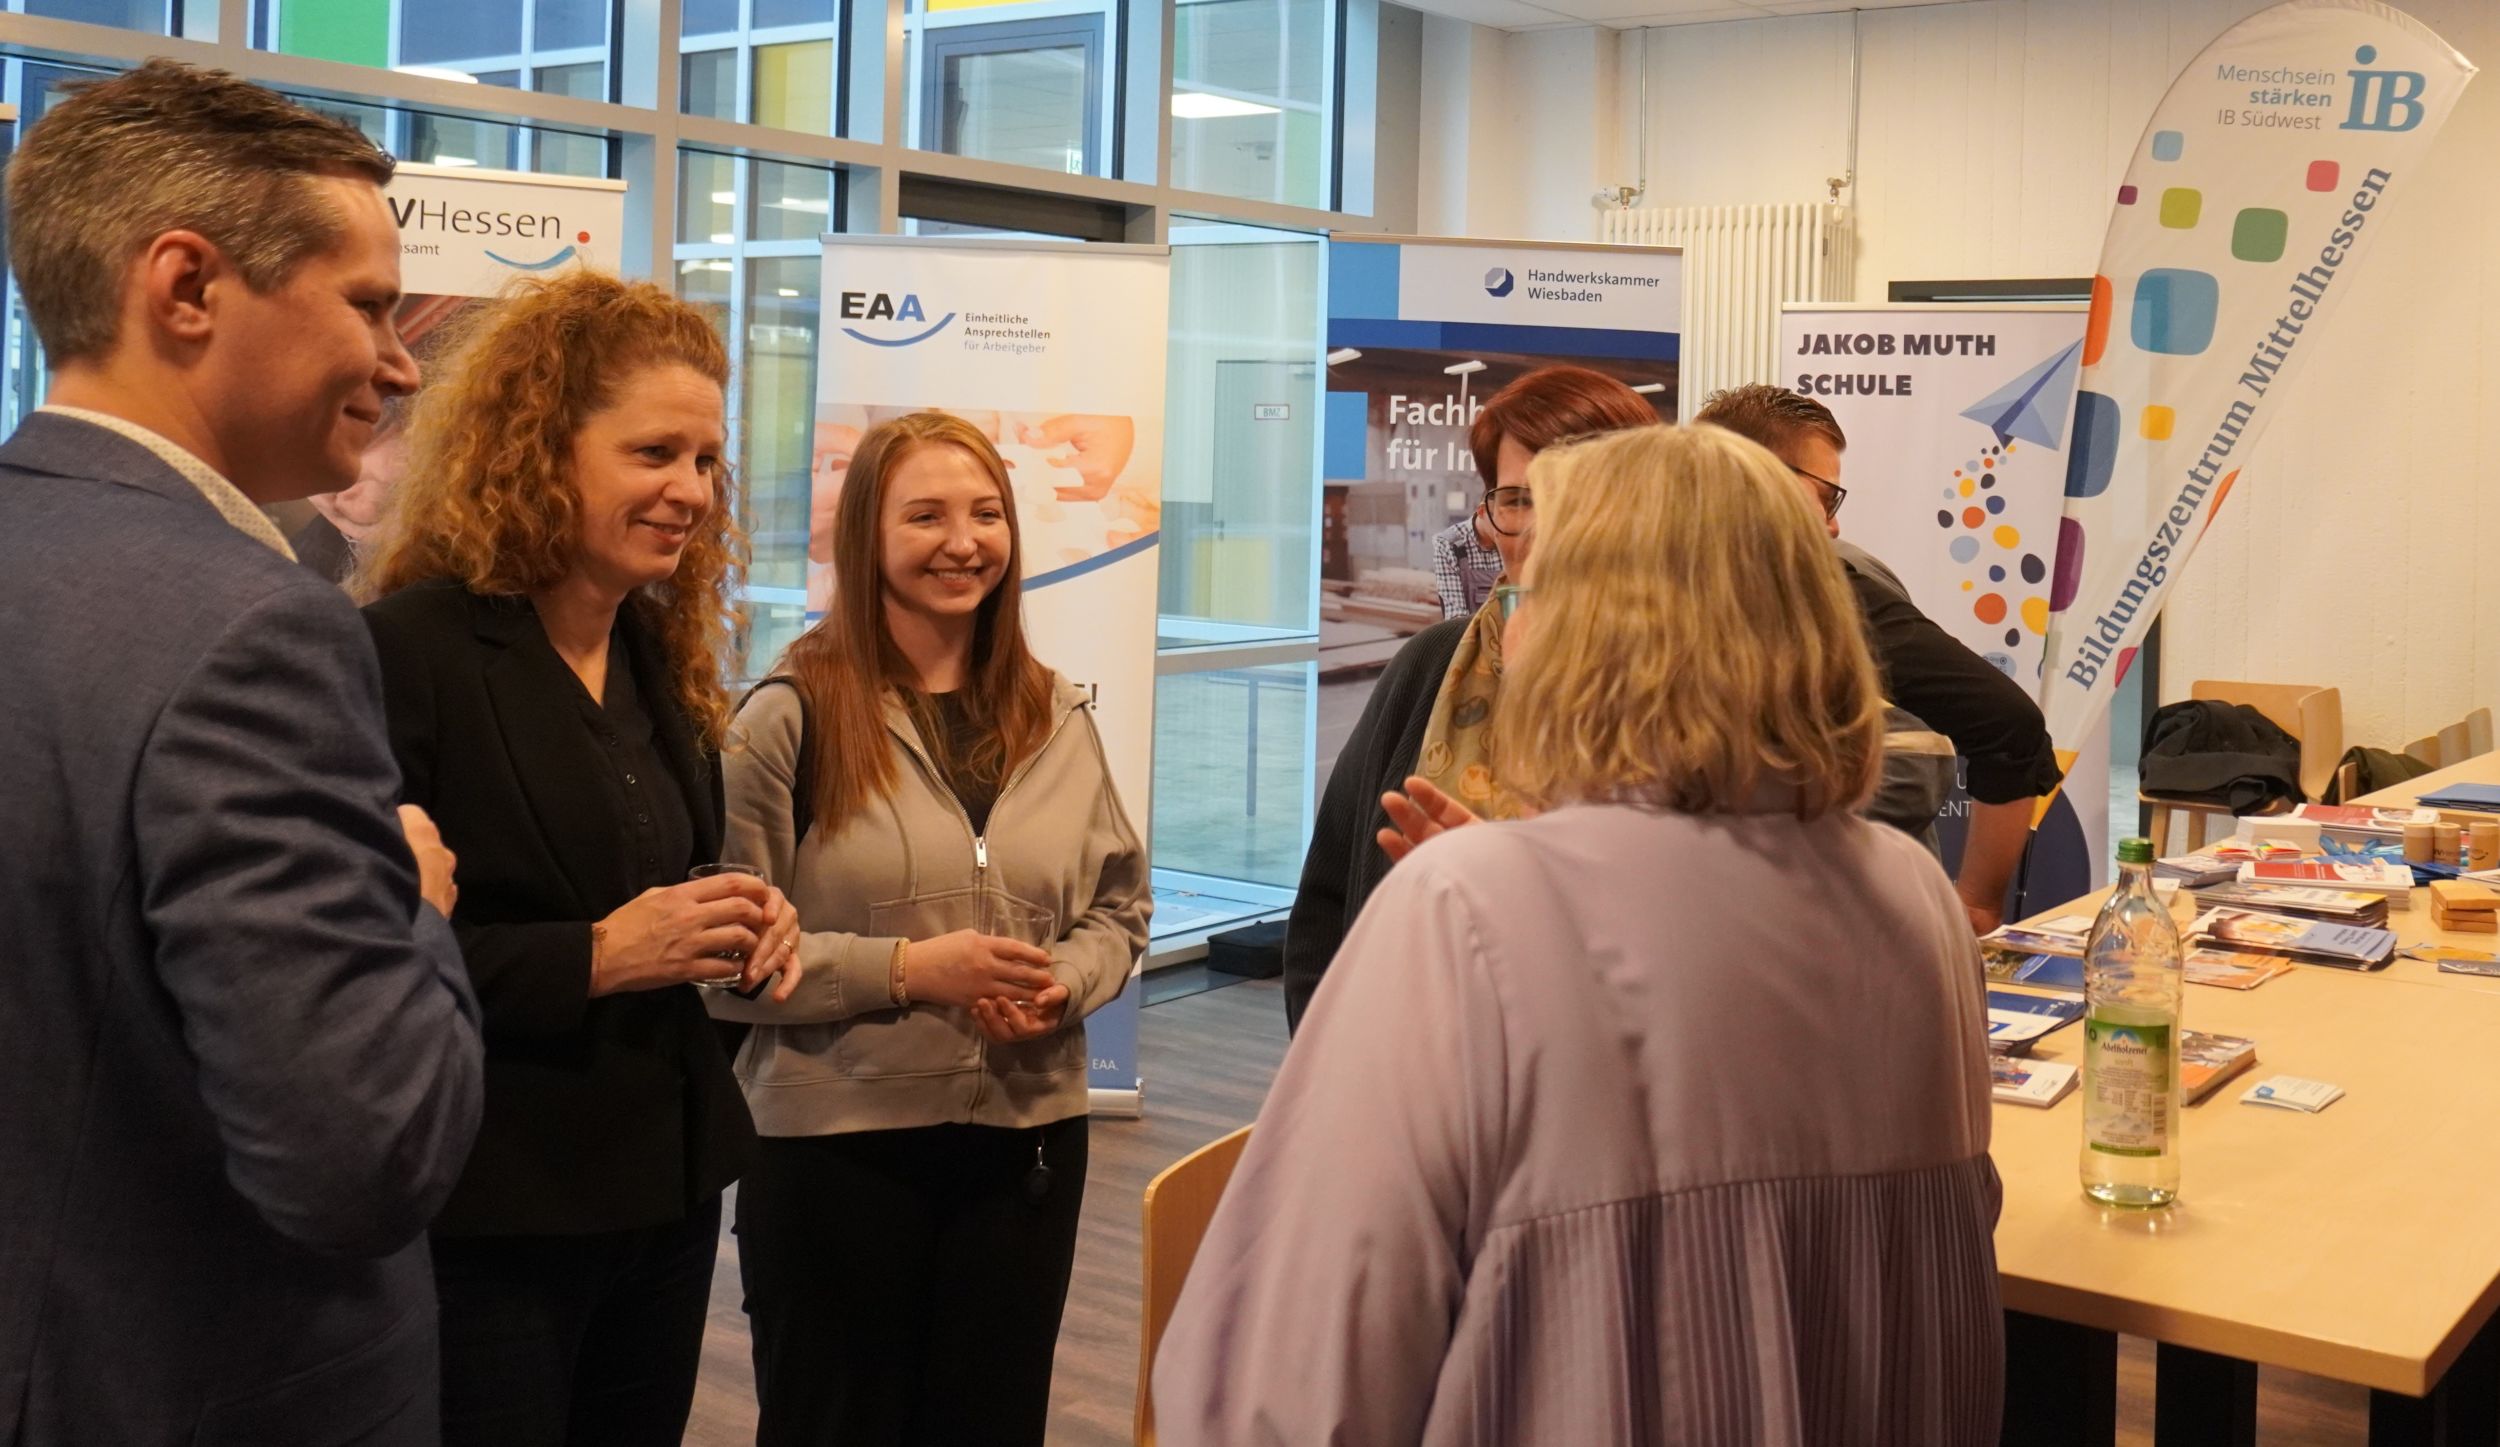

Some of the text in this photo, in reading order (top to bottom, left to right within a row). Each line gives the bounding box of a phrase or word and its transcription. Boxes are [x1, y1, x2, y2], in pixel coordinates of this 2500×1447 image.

[2217, 64, 2336, 86] Menschsein
[2249, 88, 2332, 107] stärken
[2217, 109, 2321, 131] IB Südwest
[1528, 268, 1660, 288] Handwerkskammer
[1528, 287, 1602, 303] Wiesbaden
[840, 291, 926, 322] EAA
[965, 312, 1029, 325] Einheitliche
[964, 327, 1051, 341] Ansprechstellen
[1797, 333, 1996, 356] JAKOB MUTH
[964, 340, 1047, 355] für Arbeitgeber
[1797, 373, 1912, 396] SCHULE
[2066, 166, 2392, 692] Bildungszentrum Mittelhessen
[1387, 438, 1438, 471] für
[1092, 1058, 1119, 1071] EAA.
